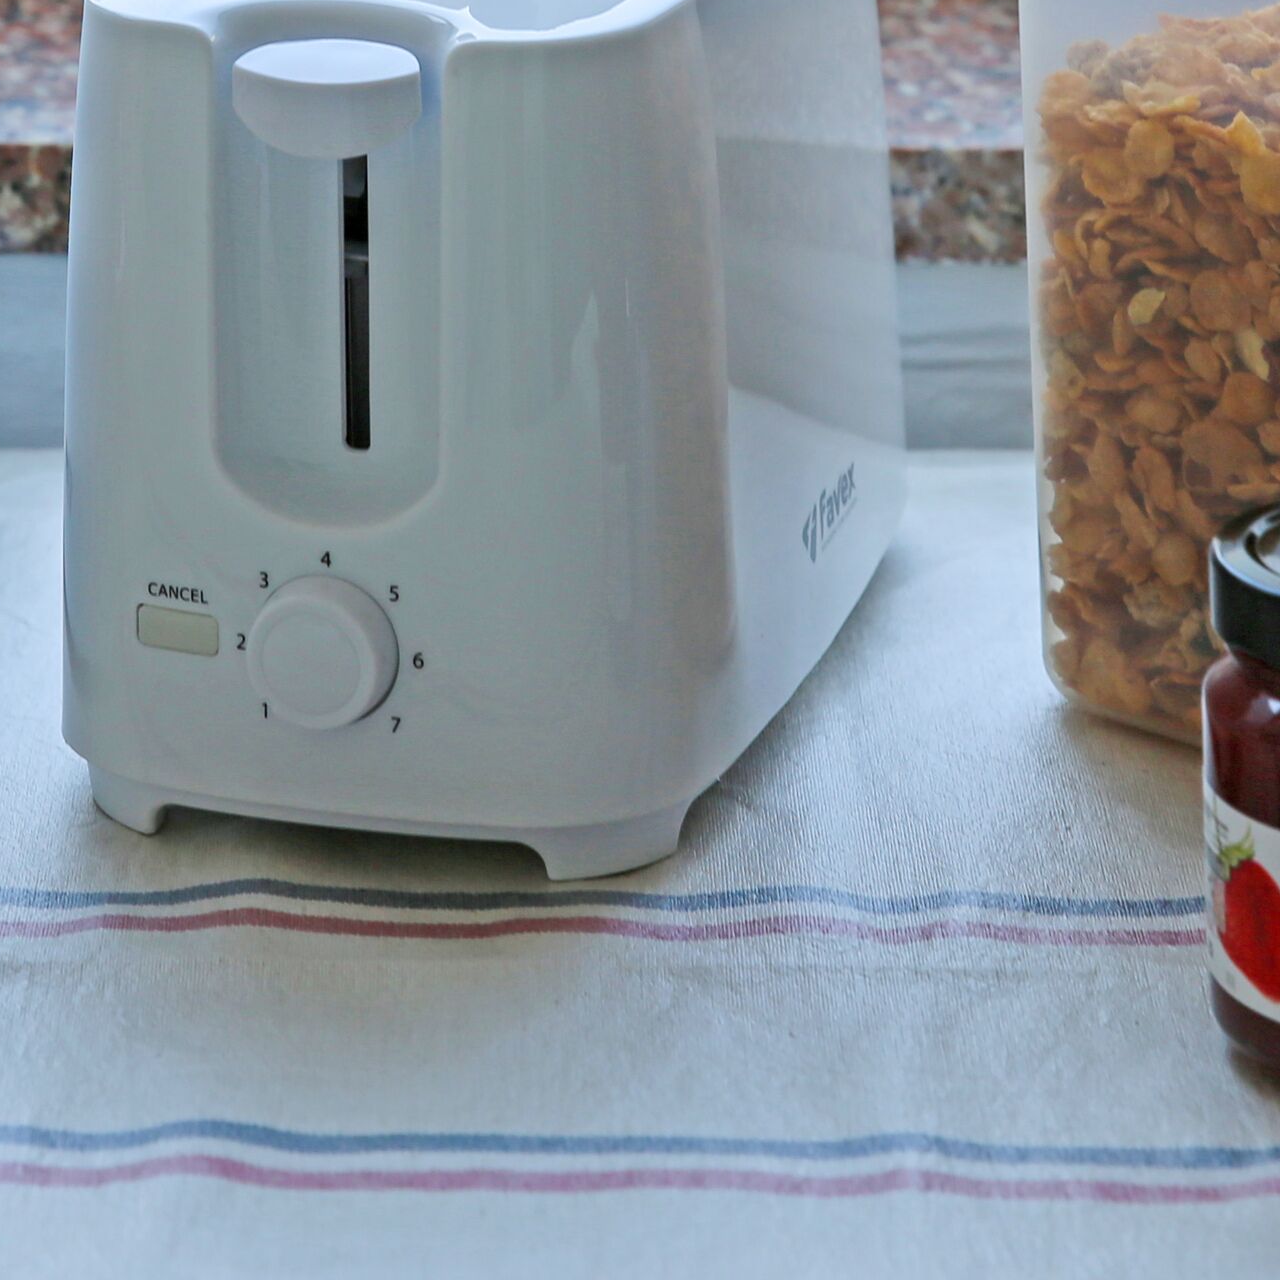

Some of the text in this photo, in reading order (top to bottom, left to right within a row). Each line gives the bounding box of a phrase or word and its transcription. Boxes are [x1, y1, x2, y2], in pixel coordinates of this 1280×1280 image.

[819, 461, 856, 540] Favex
[320, 551, 332, 568] 4
[259, 572, 270, 589] 3
[147, 581, 209, 605] CANCEL
[389, 585, 400, 602] 5
[236, 633, 247, 651] 2
[412, 652, 425, 670] 6
[262, 702, 269, 718] 1
[390, 717, 402, 733] 7
